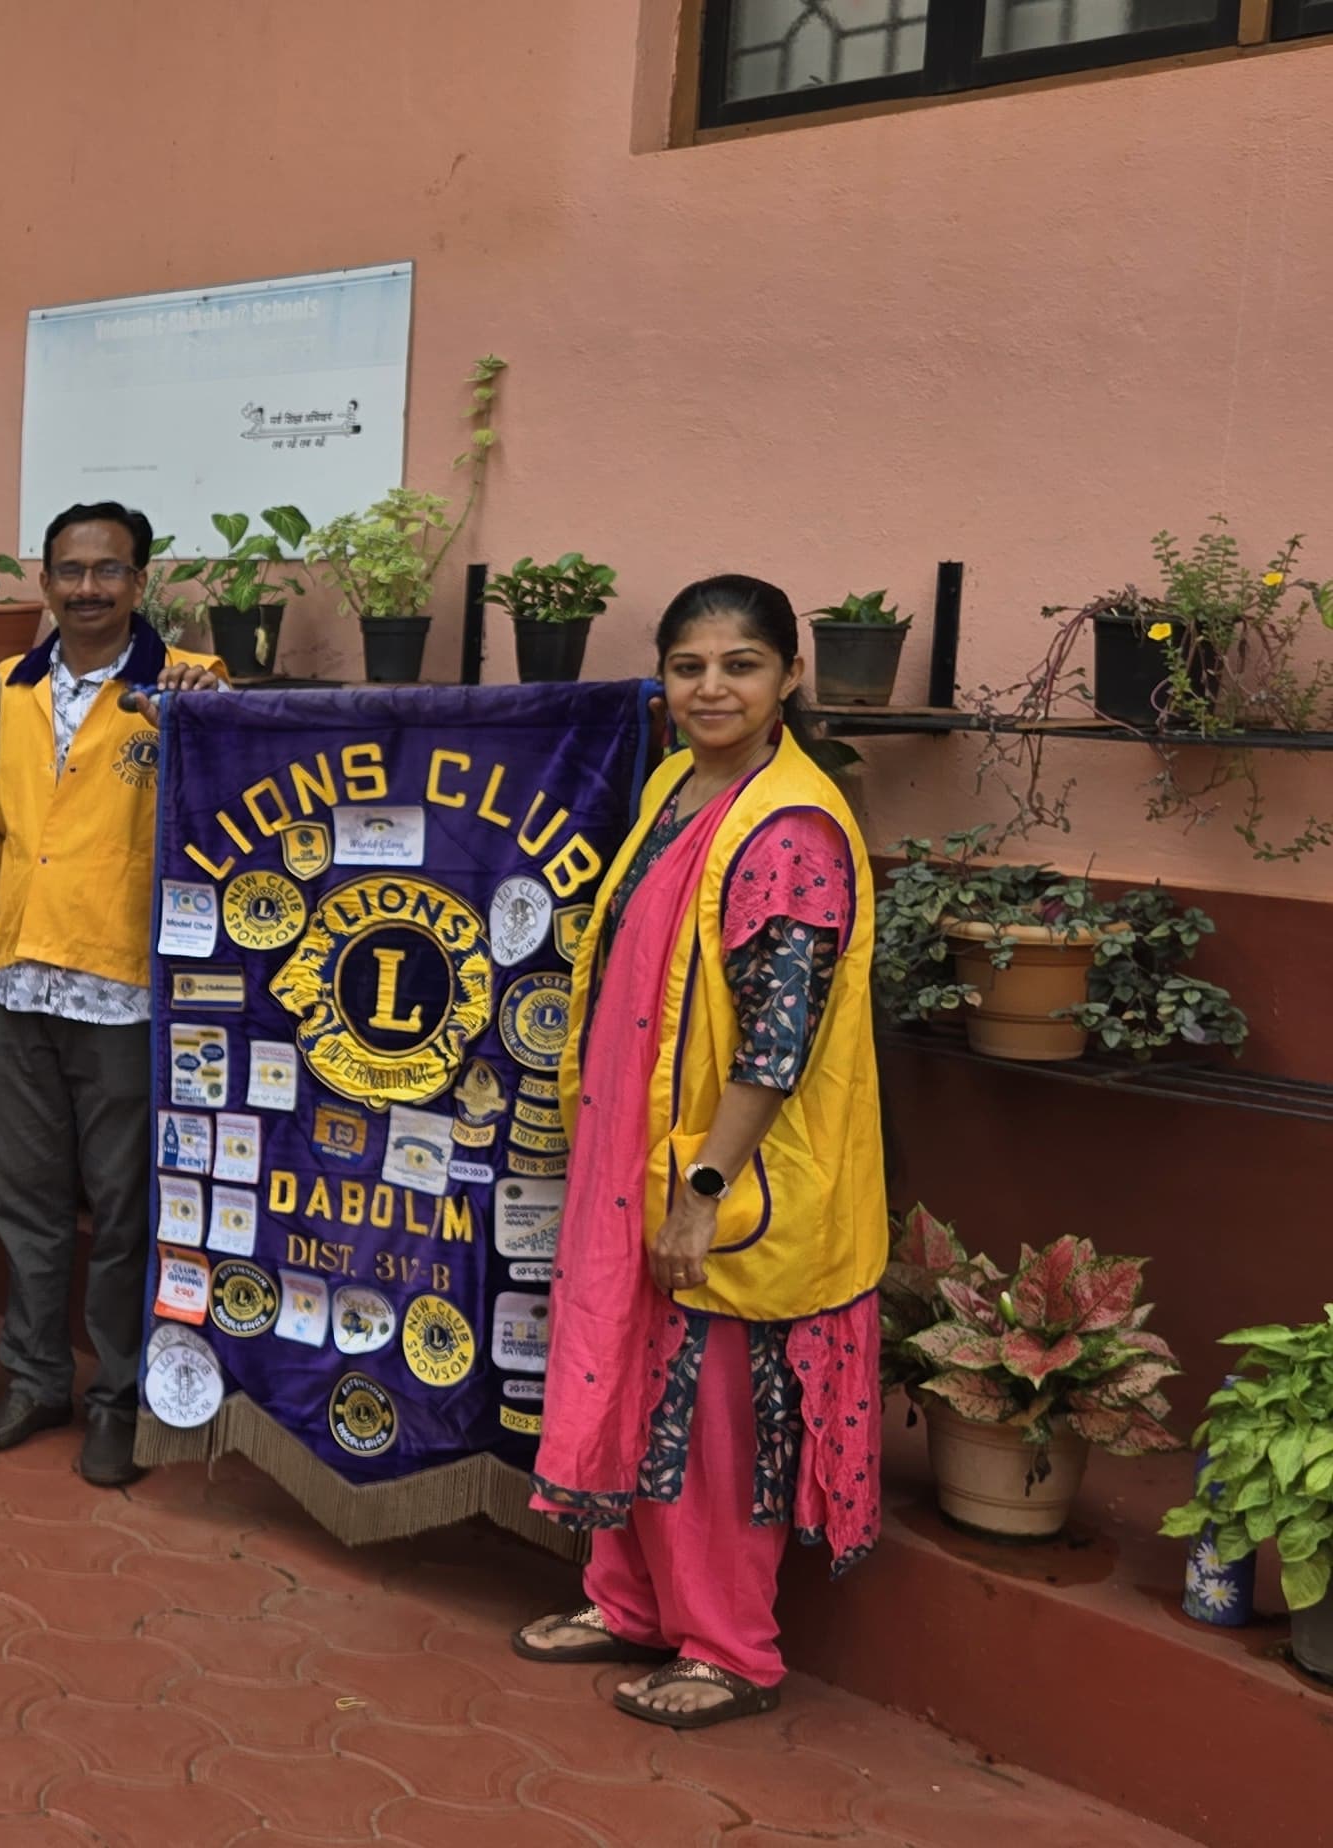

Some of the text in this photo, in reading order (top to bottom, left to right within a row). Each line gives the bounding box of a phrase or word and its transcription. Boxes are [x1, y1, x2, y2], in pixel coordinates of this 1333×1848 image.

[252, 297, 318, 325] Schools
[184, 742, 602, 898] LIONS CLUB
[349, 840, 404, 849] World Class
[228, 875, 302, 912] NEW CLUB
[493, 877, 548, 912] LEO CLUB
[166, 918, 213, 930] Model Club
[227, 912, 298, 945] SPONSOR
[333, 883, 470, 942] LIONS
[368, 947, 422, 1034] L
[321, 1039, 437, 1090] INTERNATIONAL
[269, 1170, 473, 1243] DABOLIM
[172, 1263, 197, 1276] CLUB
[287, 1233, 357, 1278] DIST.
[167, 1271, 203, 1288] GIVING
[406, 1297, 430, 1332] NEW
[436, 1301, 469, 1342] CLUB
[154, 1349, 212, 1377] LEO CLUB
[406, 1340, 469, 1381] SPONSOR
